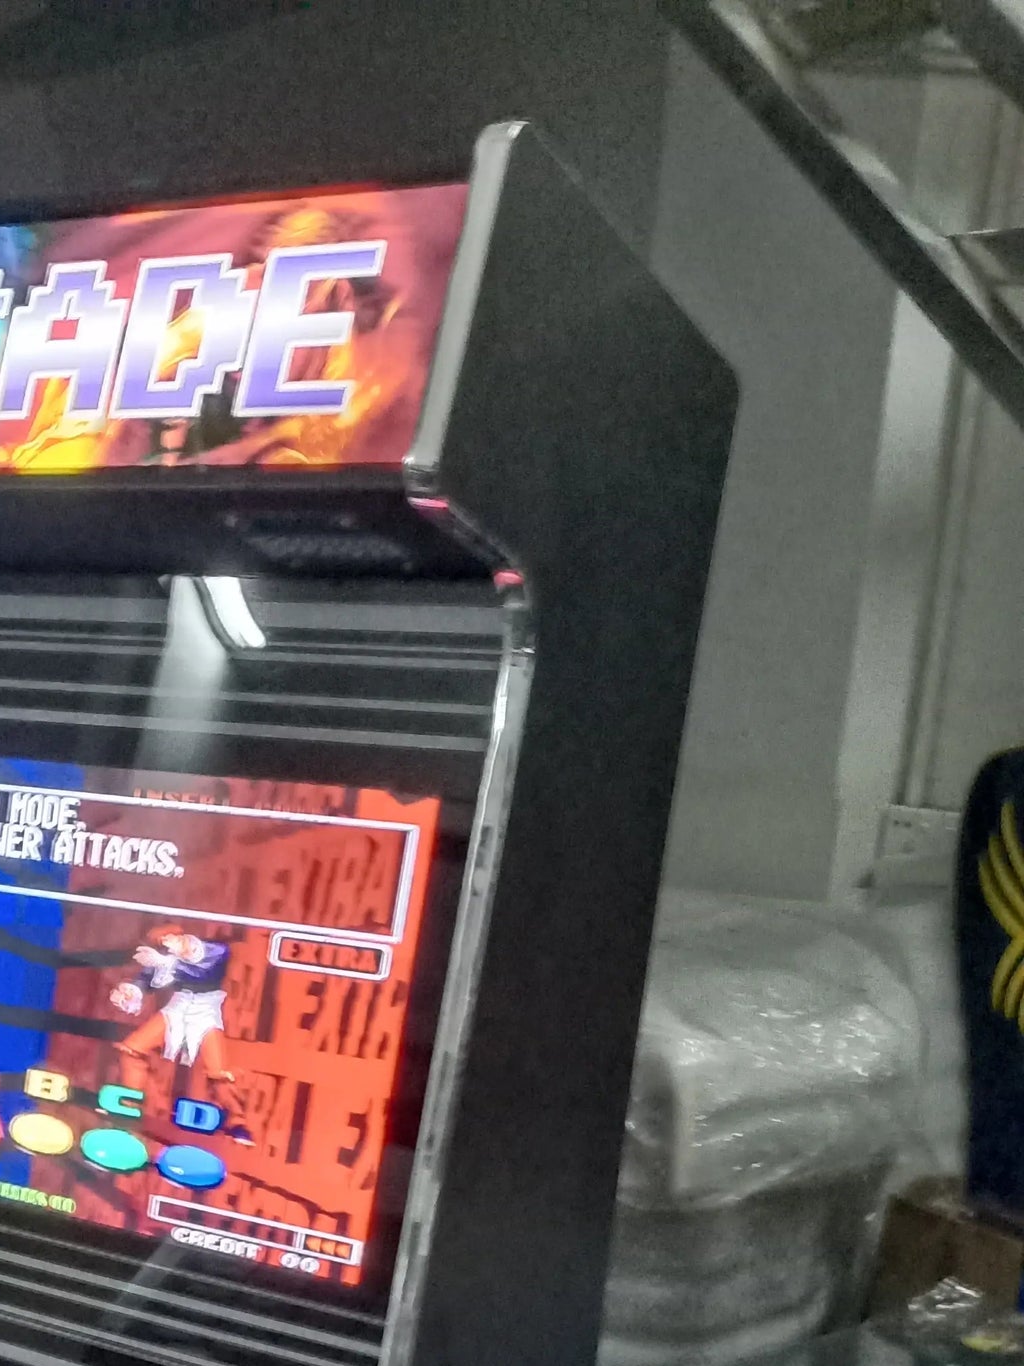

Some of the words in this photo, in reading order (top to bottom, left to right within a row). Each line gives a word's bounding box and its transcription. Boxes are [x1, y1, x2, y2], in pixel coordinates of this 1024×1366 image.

[51, 829, 185, 878] ATTACKS.
[281, 938, 378, 974] EXTRA
[24, 1068, 70, 1102] B
[98, 1084, 144, 1117] C
[173, 1097, 222, 1133] D
[170, 1225, 261, 1261] CREDIT
